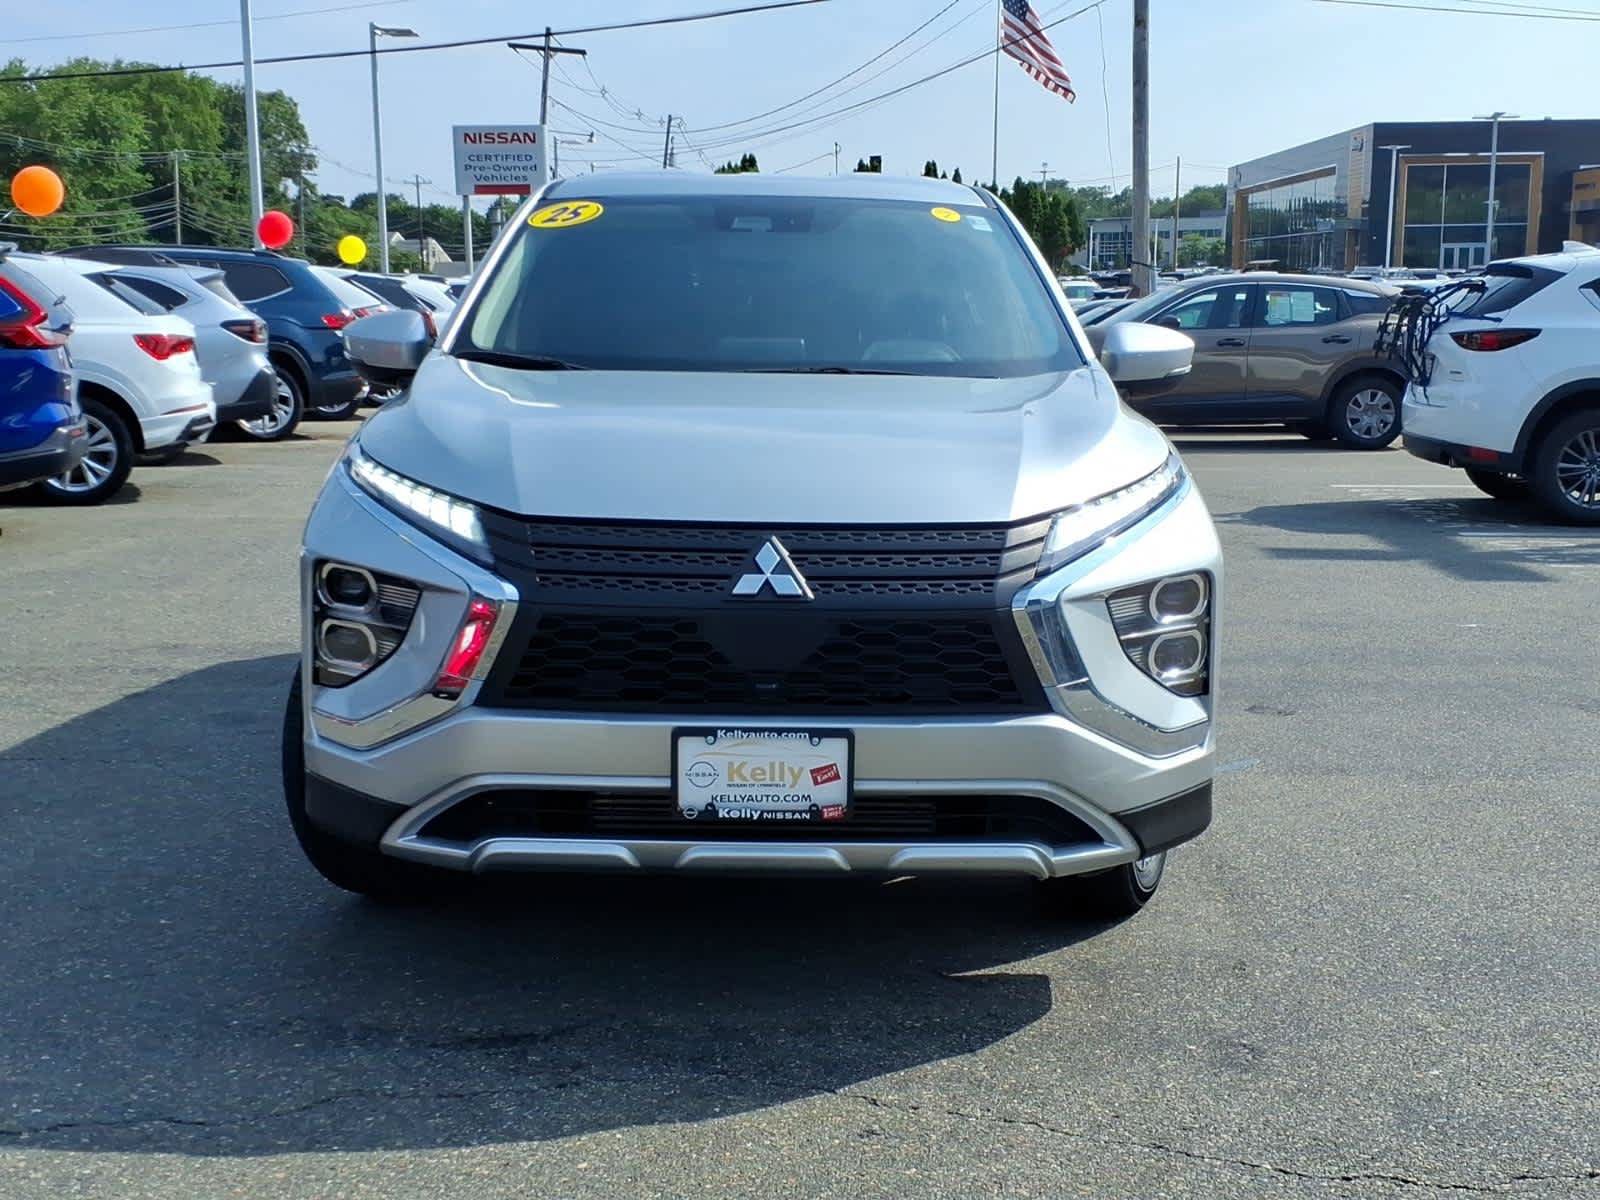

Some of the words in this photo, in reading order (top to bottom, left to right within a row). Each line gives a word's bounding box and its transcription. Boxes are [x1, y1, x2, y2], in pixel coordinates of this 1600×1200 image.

[463, 132, 536, 144] NISSAN
[467, 153, 533, 162] CERTIFIED
[464, 164, 537, 172] Pre-Owned
[473, 174, 529, 182] Vehicles
[541, 204, 590, 224] 25
[717, 729, 809, 740] Kellyauto.com
[727, 761, 804, 788] Kelly
[711, 794, 812, 803] KELLYAUTO.COM
[718, 807, 760, 820] Kelly
[763, 811, 810, 820] NISSAN
